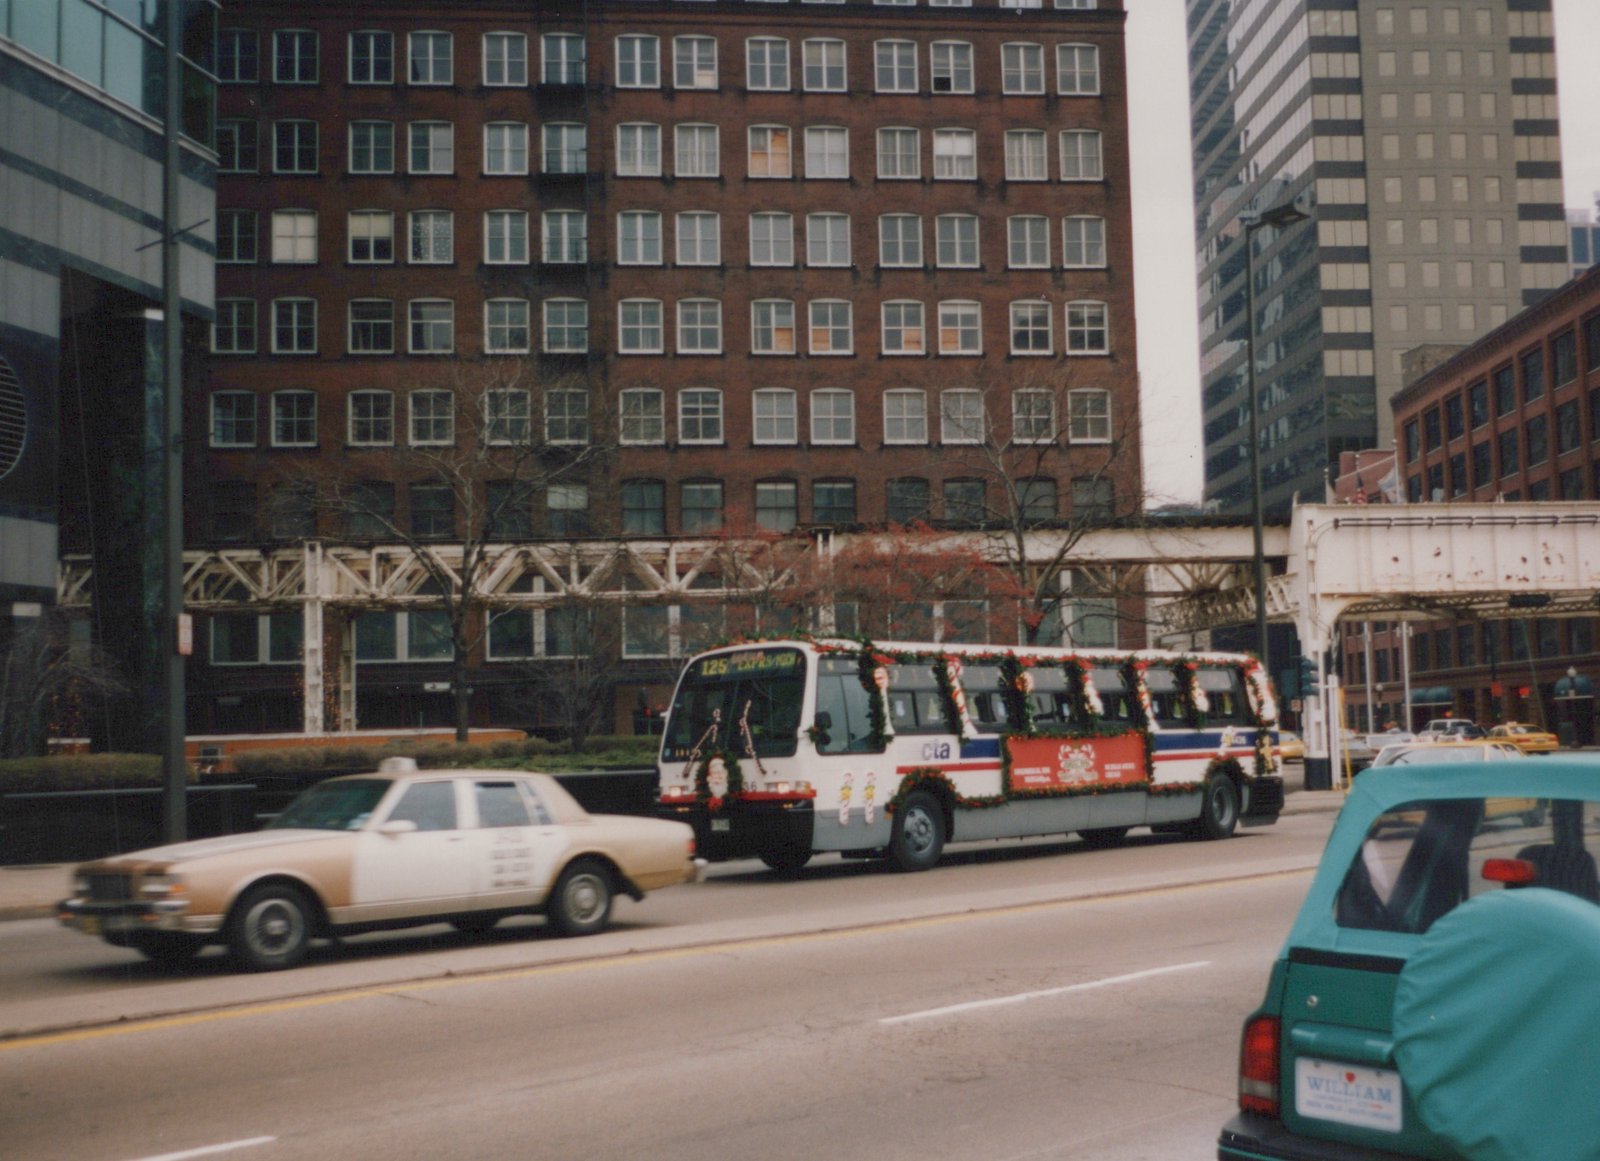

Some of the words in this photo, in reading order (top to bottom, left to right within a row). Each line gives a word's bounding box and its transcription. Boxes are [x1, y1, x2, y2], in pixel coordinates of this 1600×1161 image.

[702, 659, 728, 676] 125
[922, 740, 951, 761] cta
[1306, 1076, 1393, 1103] WILLIAM
